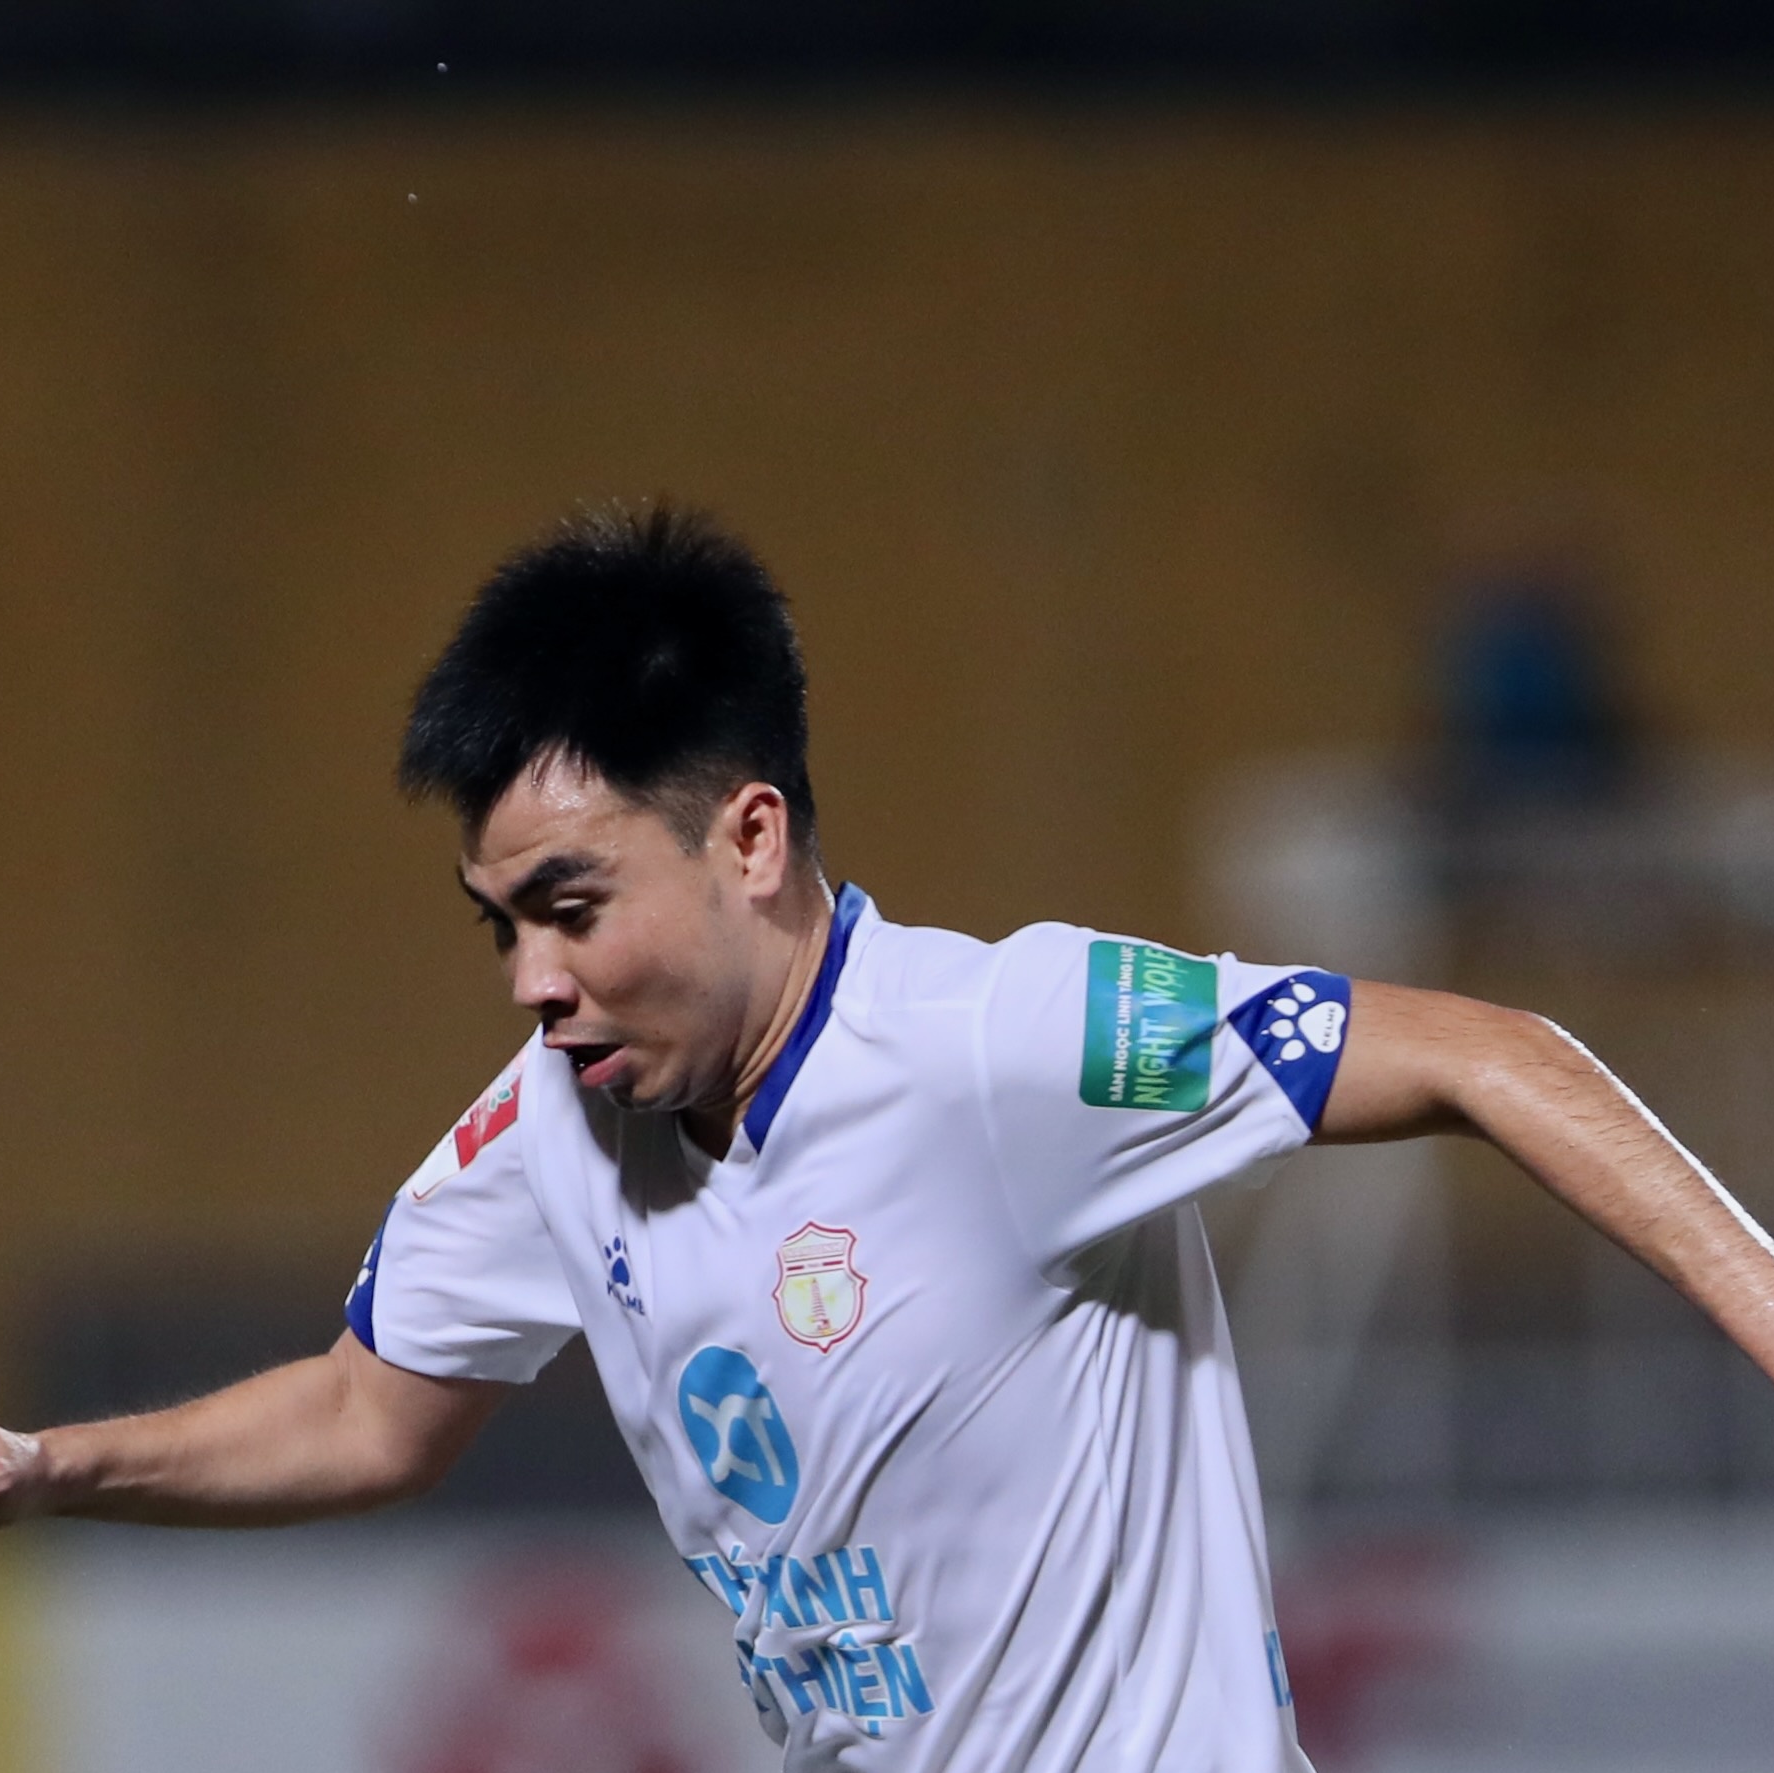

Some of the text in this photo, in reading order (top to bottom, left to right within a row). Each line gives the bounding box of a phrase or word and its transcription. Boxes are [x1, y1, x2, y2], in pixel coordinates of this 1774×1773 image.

[1117, 994, 1132, 1026] LINH
[1132, 947, 1188, 1104] NIGHT WOLF
